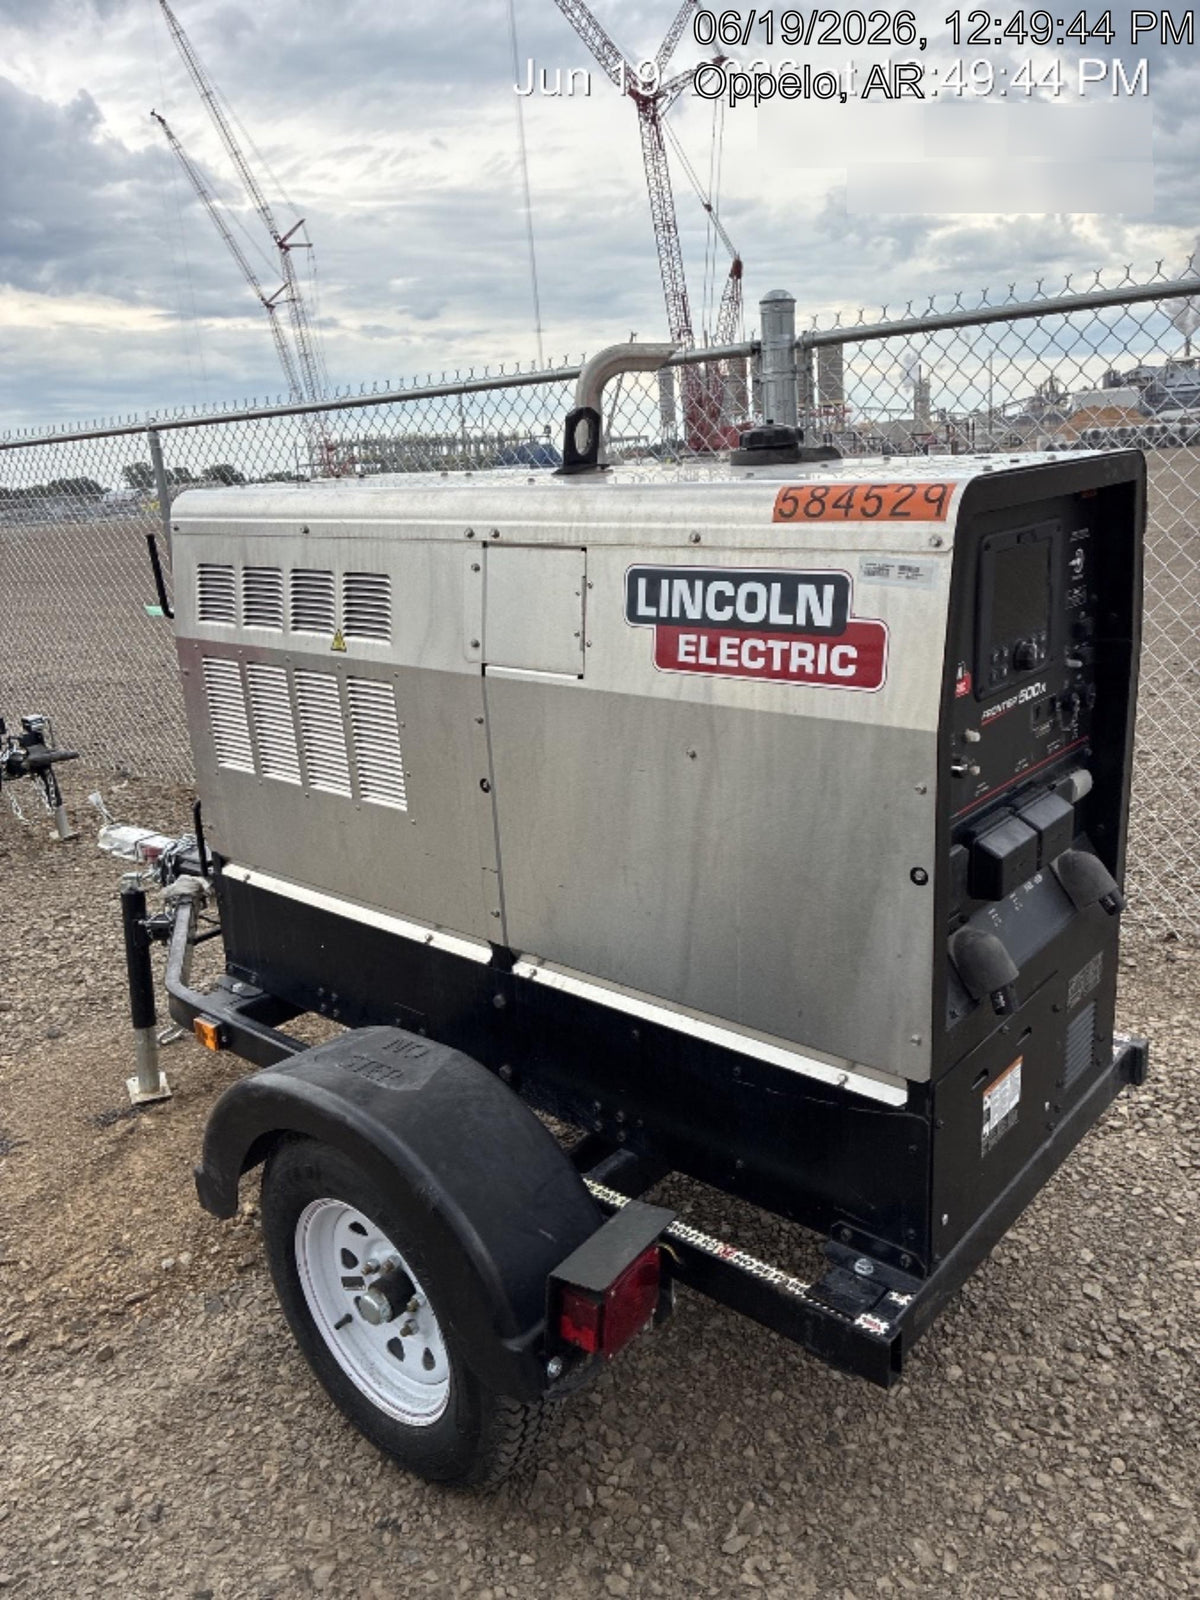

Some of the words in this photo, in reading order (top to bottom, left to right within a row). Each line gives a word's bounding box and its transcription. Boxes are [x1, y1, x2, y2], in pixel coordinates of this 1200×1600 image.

[777, 484, 949, 518] 584529
[636, 577, 836, 628] LINCOLN
[677, 633, 858, 677] ELECTRIC
